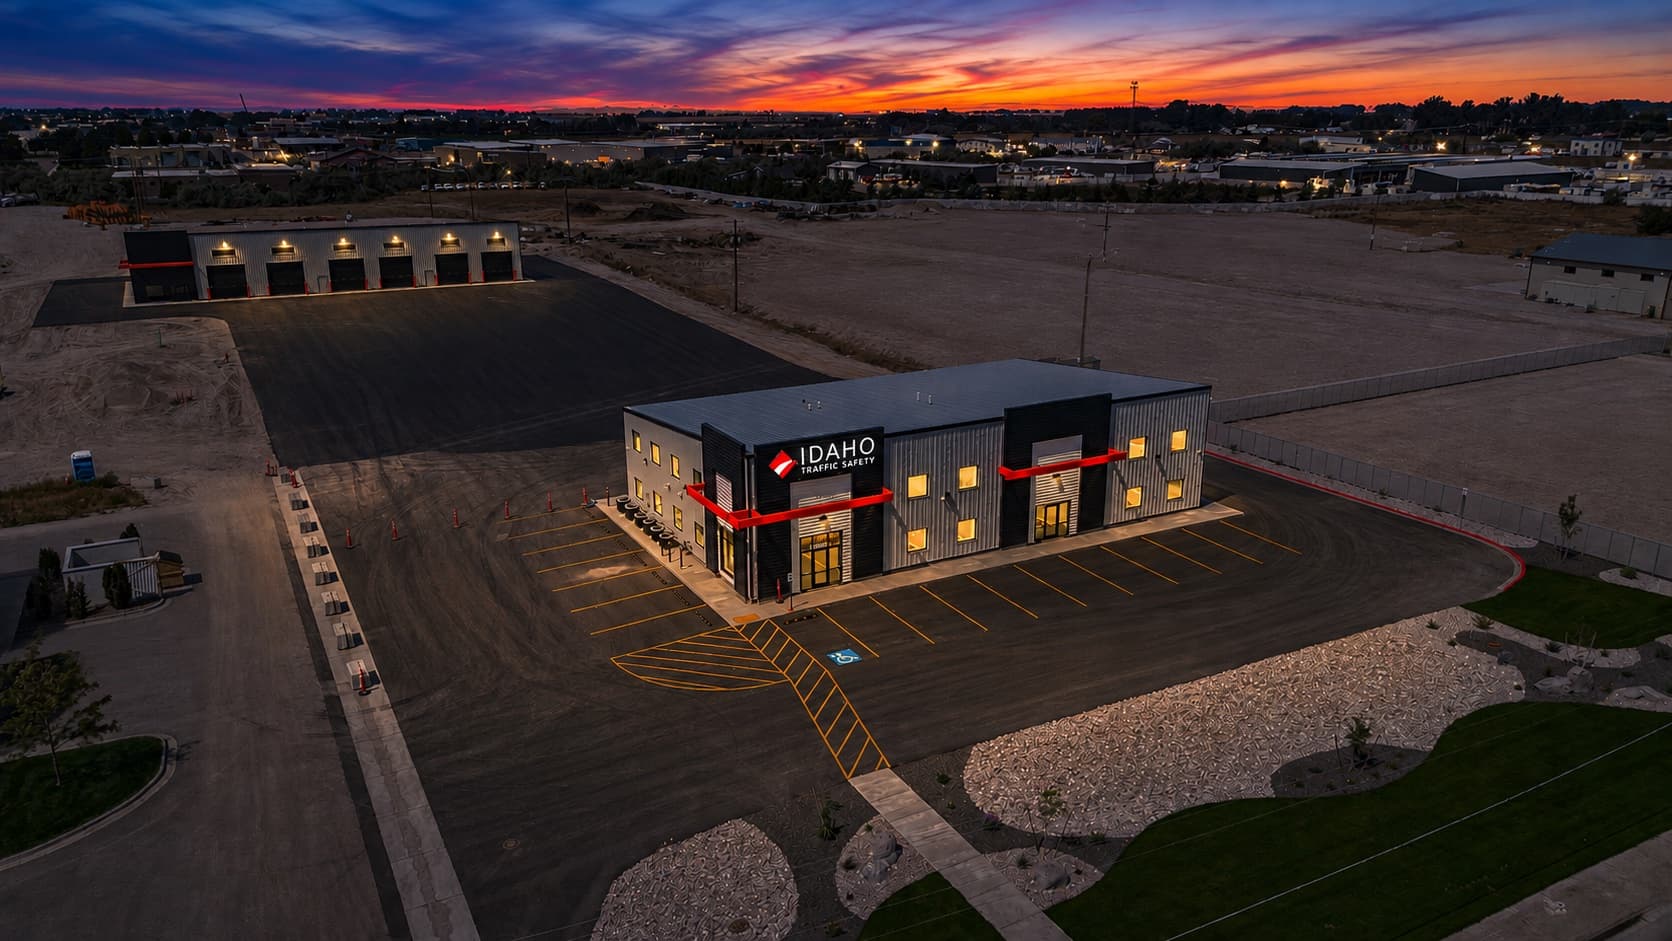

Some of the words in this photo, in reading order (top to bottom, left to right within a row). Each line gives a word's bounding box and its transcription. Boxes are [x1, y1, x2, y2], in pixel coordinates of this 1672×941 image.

[801, 437, 875, 465] IDAHO
[801, 462, 838, 475] TRAFFIC
[842, 456, 875, 469] SAFETY
